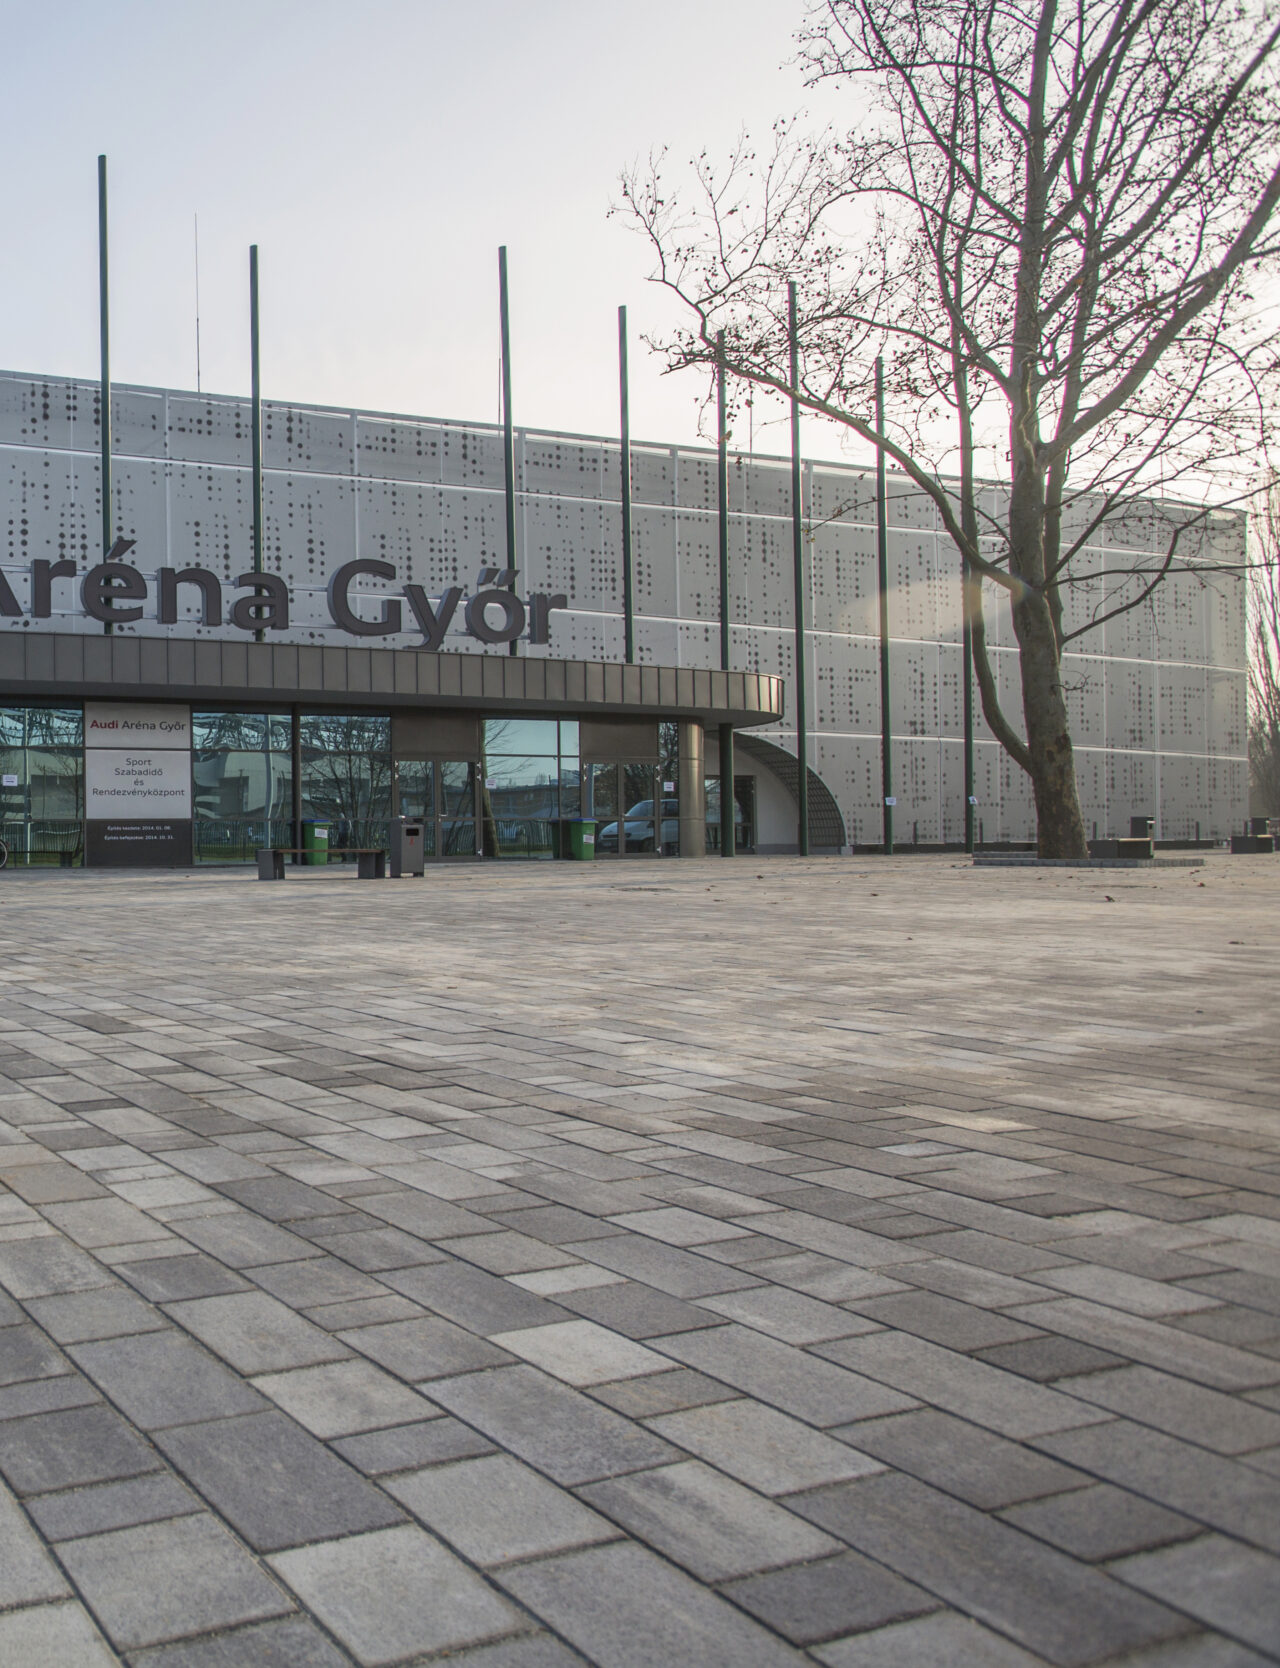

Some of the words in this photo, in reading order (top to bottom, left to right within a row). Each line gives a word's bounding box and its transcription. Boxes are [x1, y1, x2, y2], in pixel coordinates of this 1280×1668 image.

[327, 558, 568, 651] Győr
[90, 719, 119, 729] Audi
[121, 719, 156, 731] Aréna
[159, 720, 187, 733] Győr
[125, 758, 152, 768] Sport
[114, 767, 163, 776] Szabadidő
[133, 778, 145, 786] és
[92, 788, 185, 798] Rendezvényközpont
